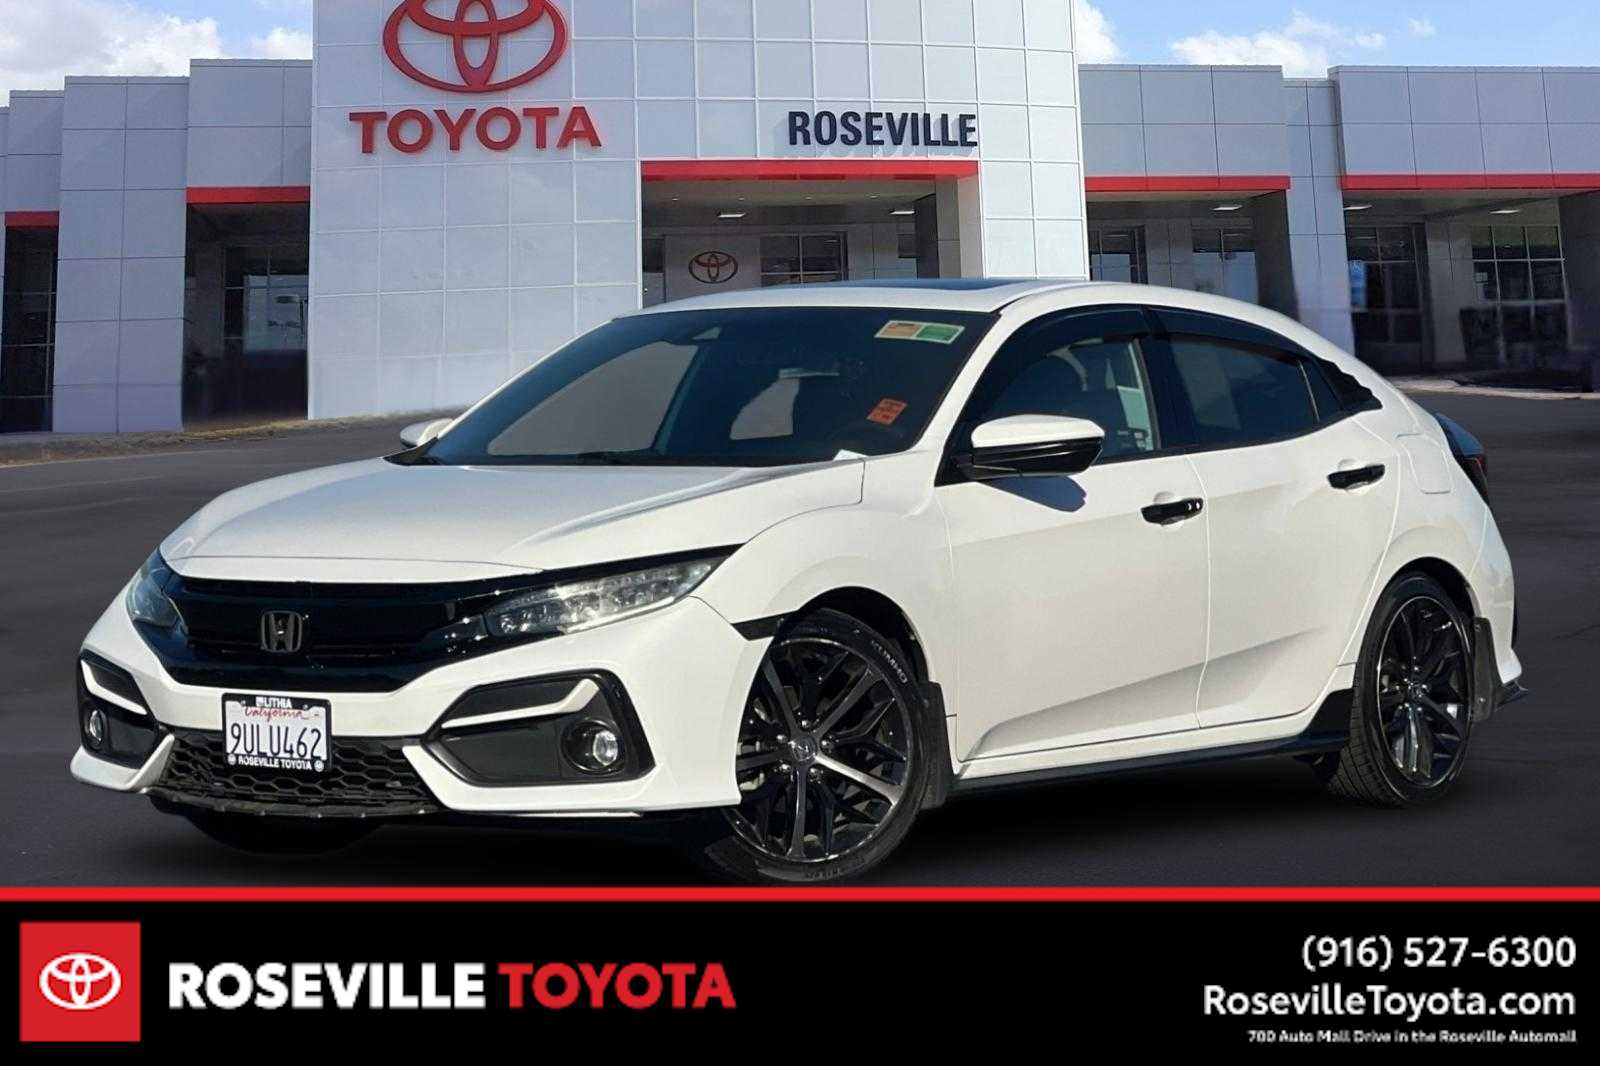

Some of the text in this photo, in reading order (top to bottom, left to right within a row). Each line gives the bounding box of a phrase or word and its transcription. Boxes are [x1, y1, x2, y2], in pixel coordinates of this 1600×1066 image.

[349, 106, 602, 154] TOYOTA
[788, 111, 978, 147] ROSEVILLE
[264, 696, 293, 709] LITHIA
[230, 722, 322, 760] 9ULU462
[238, 755, 313, 771] ROSEVILLE TOYOTA
